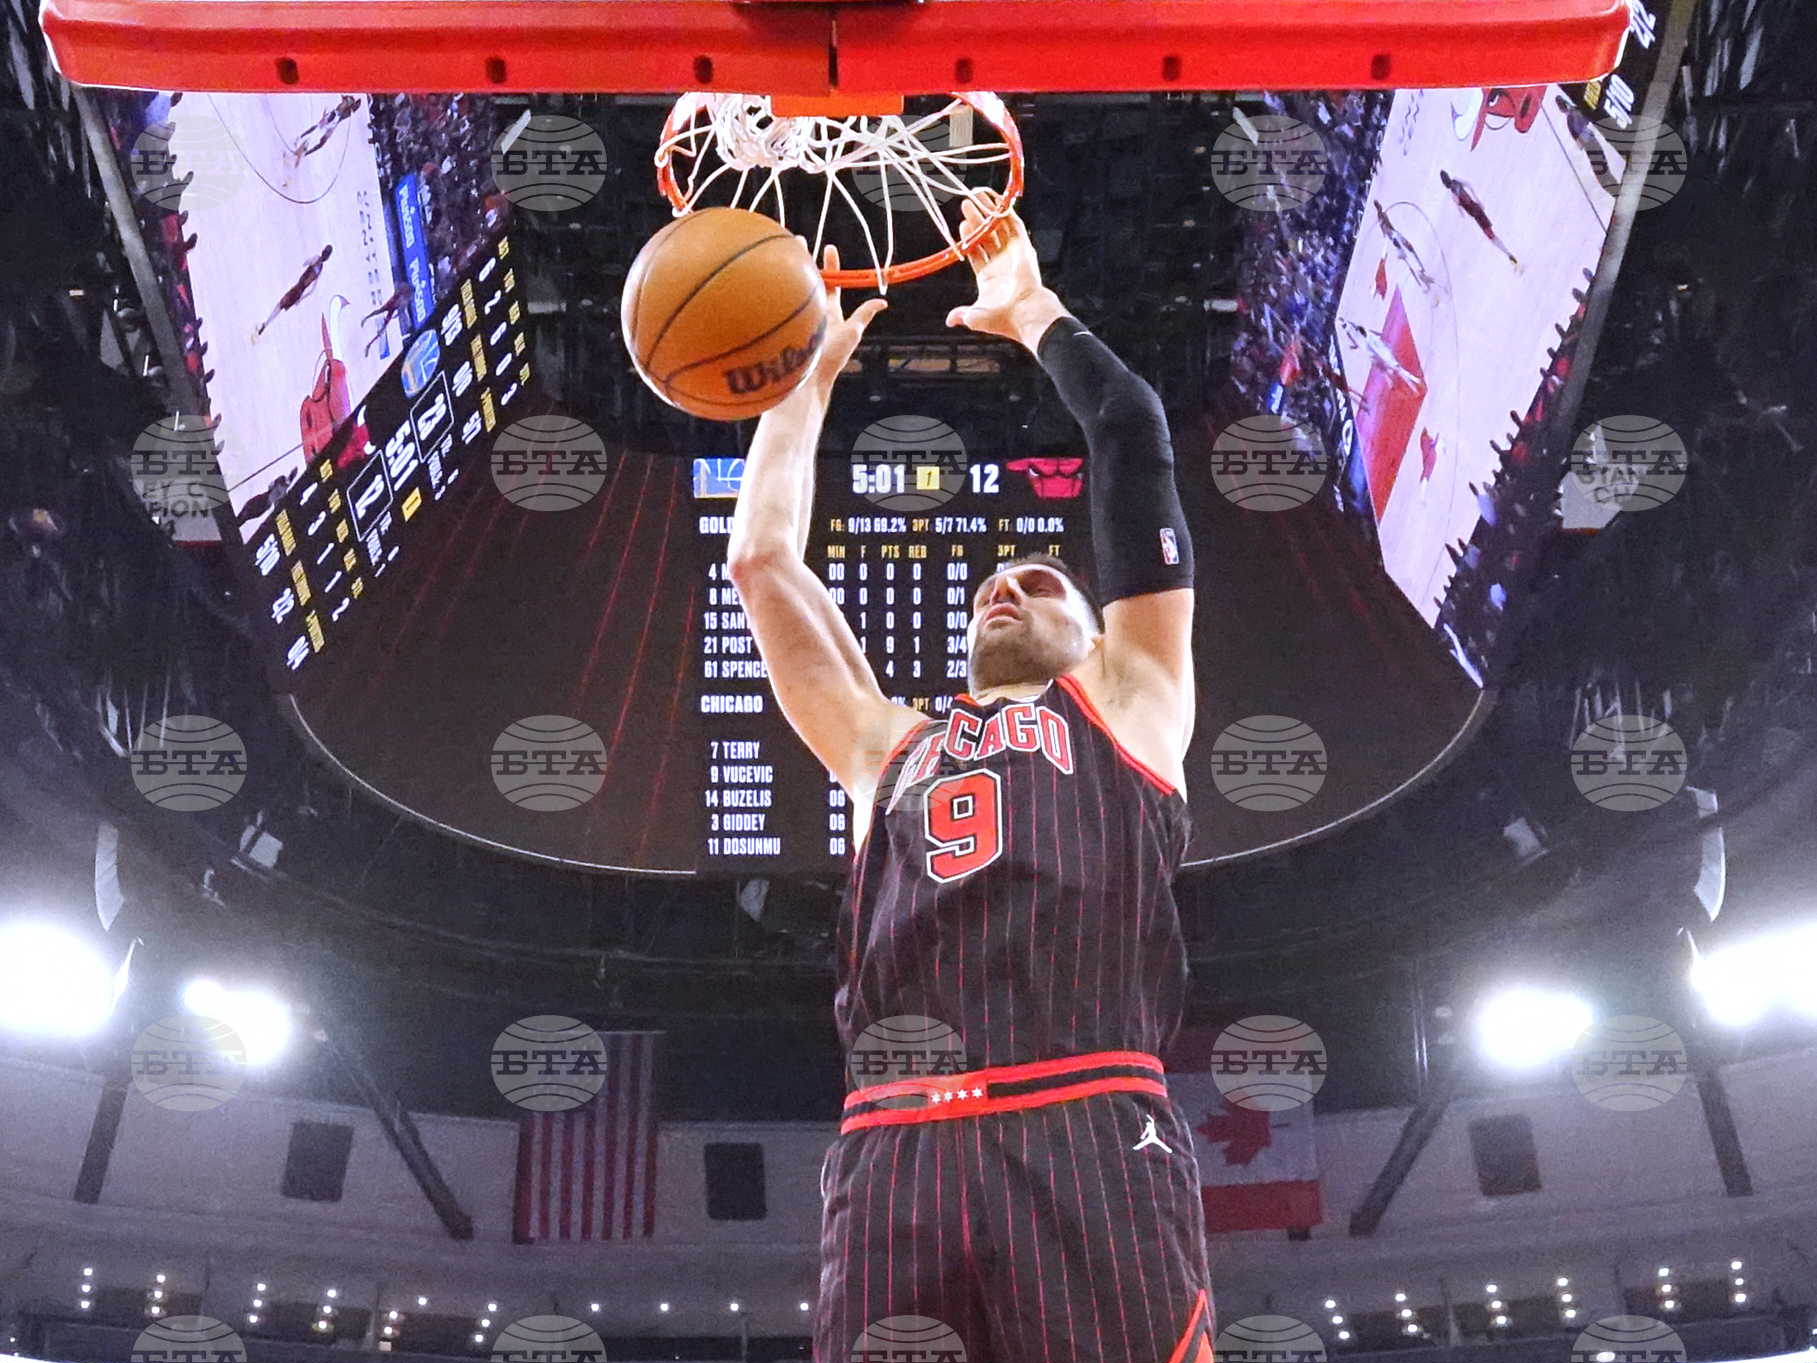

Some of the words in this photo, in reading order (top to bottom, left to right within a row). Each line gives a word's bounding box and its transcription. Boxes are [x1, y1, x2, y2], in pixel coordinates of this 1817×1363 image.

[1604, 74, 1634, 129] 5/10
[479, 257, 496, 281] 6
[484, 290, 501, 315] 2
[490, 321, 507, 345] 6
[441, 303, 463, 346] 9/13
[461, 410, 482, 444] 5/7
[496, 352, 512, 376] 0
[501, 382, 517, 406] 3
[415, 392, 447, 441] 23
[385, 419, 418, 491] 5:01
[852, 464, 905, 494] 5:01
[969, 464, 1000, 494] 12
[300, 482, 318, 506] 4
[354, 473, 385, 519] 12
[308, 511, 326, 536] 3
[848, 517, 871, 534] 9/13
[874, 517, 906, 533] 69.2%
[935, 517, 954, 534] 5/7
[956, 517, 987, 533] 71.4%
[1016, 517, 1035, 534] 0/0
[1037, 517, 1064, 533] 0.0%
[317, 542, 335, 565] 1
[827, 545, 846, 559] MIN
[861, 545, 866, 558] F
[881, 545, 900, 559] PTS
[908, 545, 927, 559] REB
[951, 545, 964, 557] FG
[997, 545, 1016, 558] 3PT
[324, 571, 342, 593] 1
[709, 562, 717, 581] 4
[828, 562, 845, 581] 00
[859, 562, 868, 581] 0
[886, 562, 895, 581] 0
[913, 562, 922, 581] 0
[947, 562, 968, 581] 0/0
[255, 533, 281, 576] 5/10
[271, 587, 294, 624] 2/2
[286, 635, 310, 671] 0/4
[709, 587, 718, 605] 8
[859, 587, 868, 605] 0
[886, 587, 895, 605] 0
[913, 587, 922, 605] 0
[947, 587, 965, 605] 0/1
[332, 597, 350, 622] 2
[703, 611, 718, 630] 15
[860, 611, 867, 630] 1
[886, 611, 895, 630] 0
[913, 611, 922, 630] 0
[947, 611, 968, 630] 0/0
[704, 636, 718, 654] 21
[721, 636, 752, 654] POST
[886, 636, 895, 654] 9
[913, 636, 920, 654] 1
[947, 636, 967, 654] 3/4
[704, 660, 718, 678] 61
[886, 660, 894, 678] 4
[913, 660, 921, 678] 3
[947, 660, 967, 678] 2/3
[700, 695, 763, 713] CHICAGO
[711, 741, 719, 759] 7
[722, 741, 760, 759] TERRY
[711, 765, 719, 783] 9
[722, 765, 773, 783] VUCEVIC
[705, 789, 718, 807] 14
[723, 789, 772, 807] BUZELIS
[829, 789, 846, 807] 06
[711, 813, 719, 831] 3
[723, 813, 766, 831] GIDDEY
[829, 813, 846, 831] 06
[924, 768, 1004, 884] 9
[708, 837, 719, 855] 11
[723, 837, 781, 855] DOSUNMU
[829, 837, 846, 855] 06
